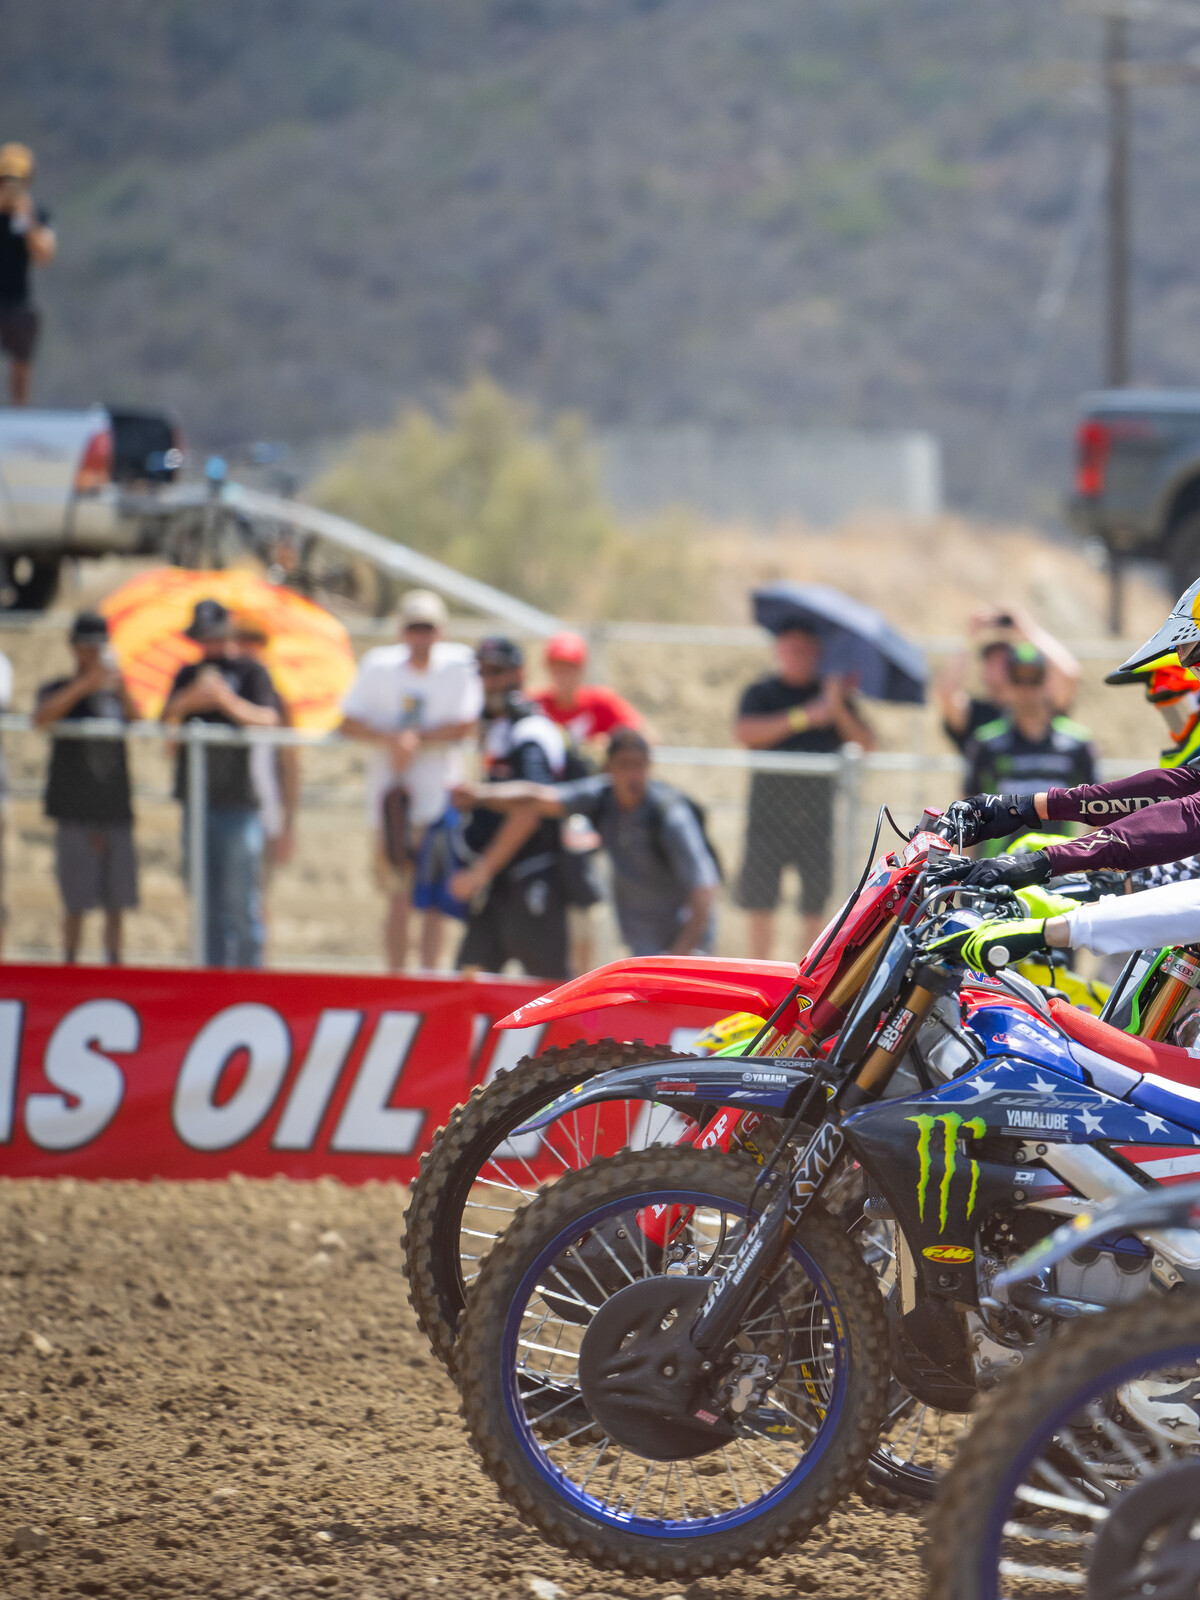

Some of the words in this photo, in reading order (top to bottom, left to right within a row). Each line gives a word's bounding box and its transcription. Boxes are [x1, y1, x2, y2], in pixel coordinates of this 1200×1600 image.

[171, 1001, 428, 1155] OIL
[752, 1073, 787, 1084] YAMAHA
[774, 1059, 812, 1068] COOPER
[1007, 1110, 1069, 1131] YAMALUBE
[785, 1122, 845, 1226] KYB
[703, 1210, 769, 1318] DUNLOP
[732, 1240, 763, 1286] BRAKING
[922, 1247, 975, 1260] FMF
